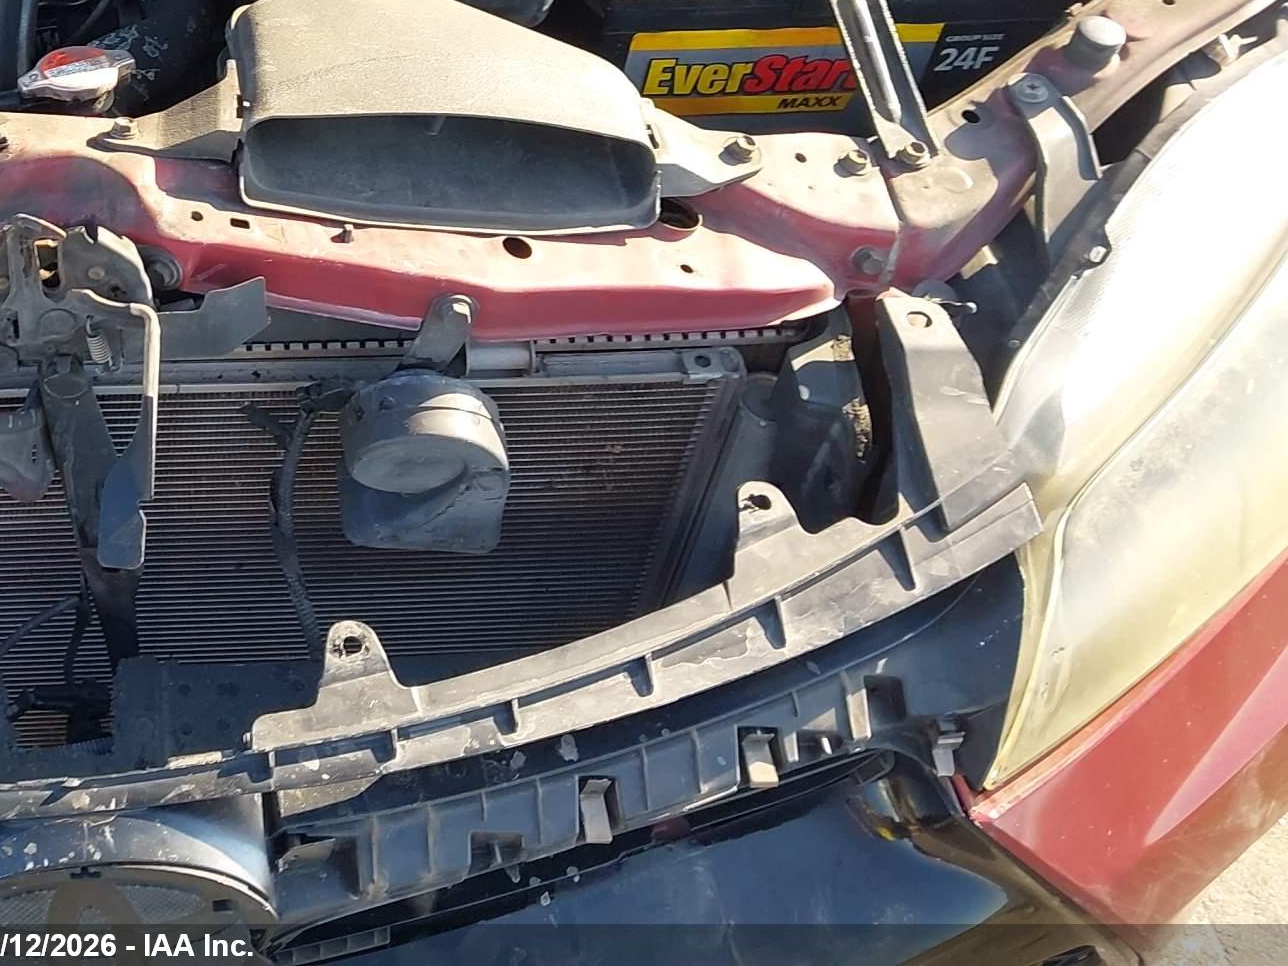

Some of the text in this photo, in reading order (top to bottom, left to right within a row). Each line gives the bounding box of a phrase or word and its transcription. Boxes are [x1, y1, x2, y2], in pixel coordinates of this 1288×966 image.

[933, 46, 1001, 72] 24F
[642, 54, 857, 96] EverStar
[777, 95, 843, 109] MAXX
